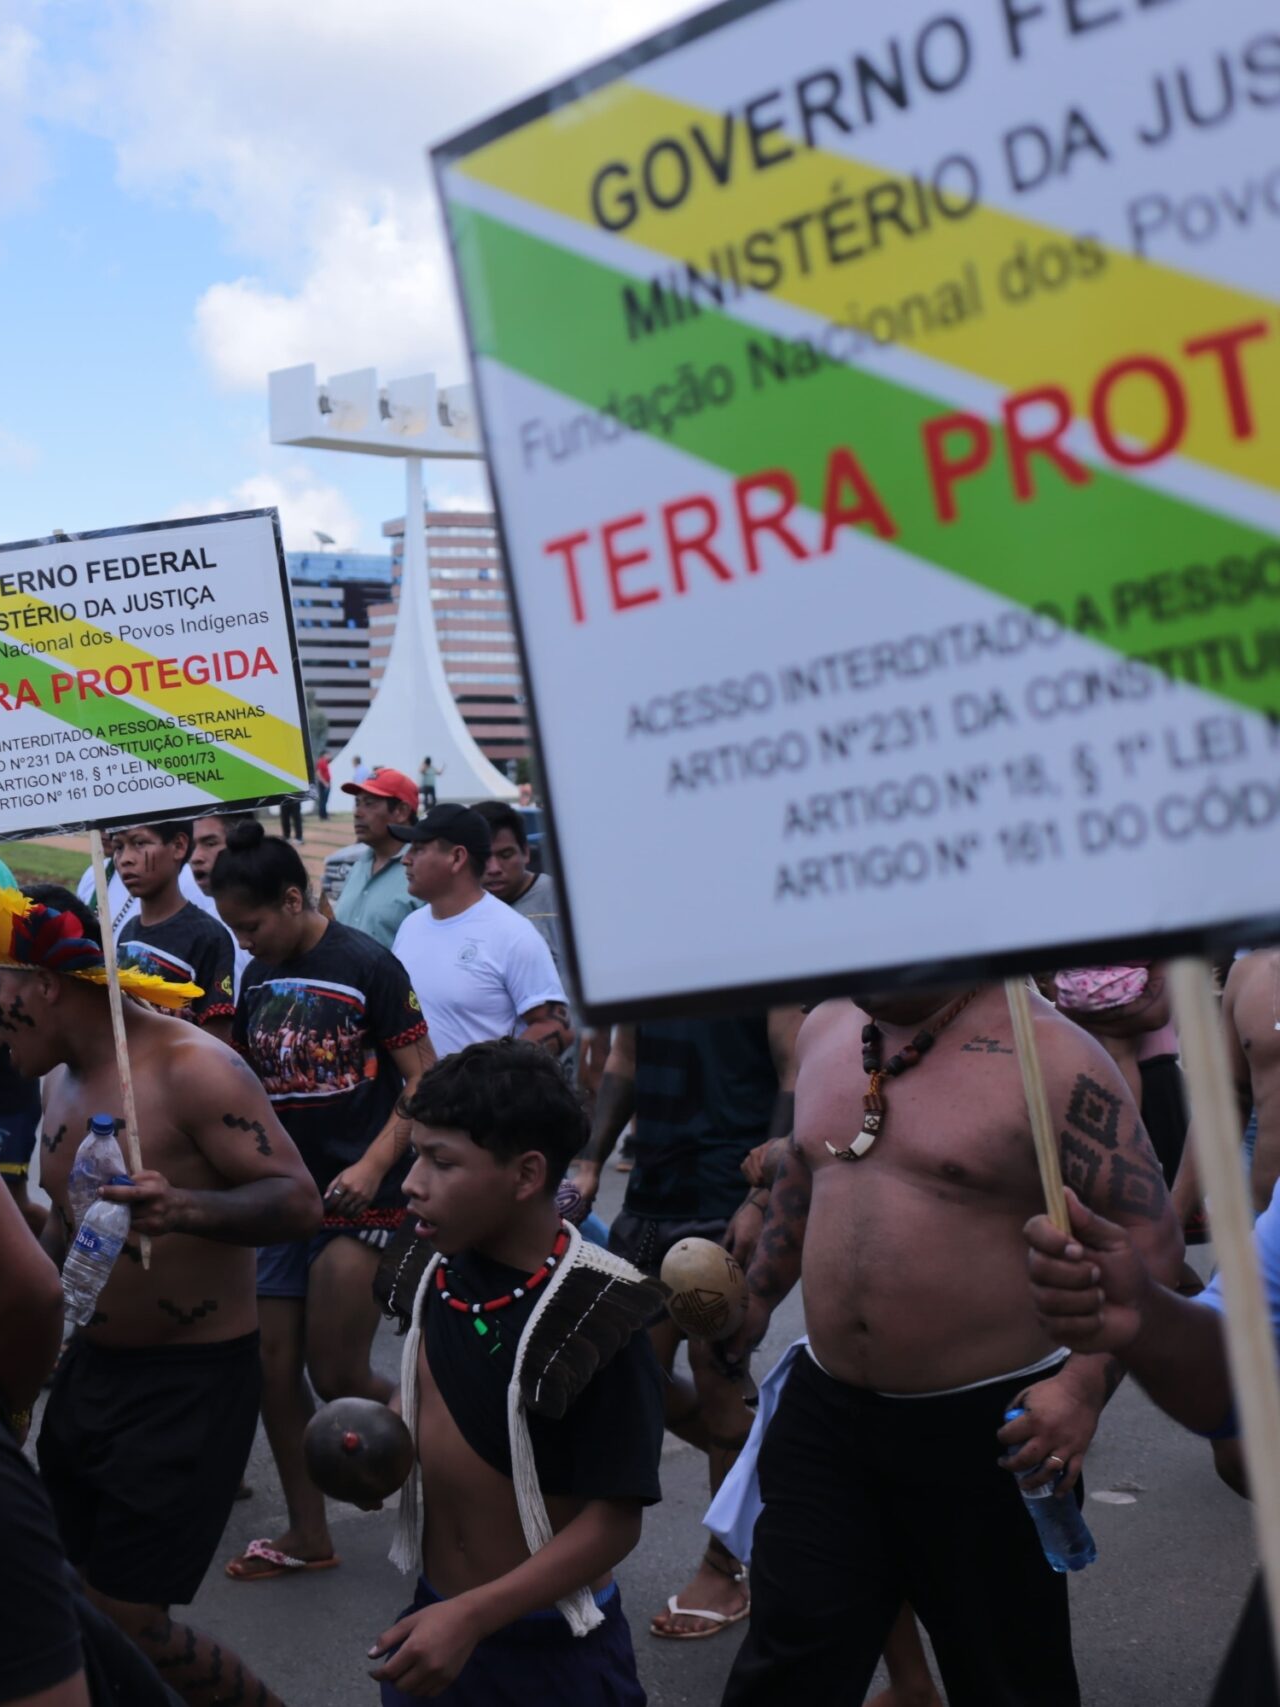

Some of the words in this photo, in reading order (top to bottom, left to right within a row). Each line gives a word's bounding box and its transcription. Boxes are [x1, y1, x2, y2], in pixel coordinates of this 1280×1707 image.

[588, 16, 971, 233] GOVERNO
[619, 153, 980, 343] MINISTÉRIO
[1002, 105, 1111, 194] DA
[518, 357, 735, 471] Fundação
[746, 262, 984, 390] Nacional
[999, 231, 1108, 306] dos
[86, 547, 217, 584] FEDERAL
[542, 445, 900, 625] TERRA
[80, 630, 113, 648] dos
[119, 622, 175, 642] Povos
[180, 610, 270, 634] Indígenas
[84, 598, 116, 618] DA
[122, 585, 216, 613] JUSTIÇA
[51, 646, 279, 704] PROTEGIDA
[627, 671, 775, 740] ACESSO
[779, 603, 1066, 706] INTERDITADO
[55, 750, 76, 764] DA
[79, 734, 184, 762] CONSTITUIÇÃO
[187, 727, 252, 746] FEDERAL
[95, 726, 106, 739] A
[109, 717, 176, 737] PESSOAS
[178, 705, 266, 728] ESTRANHAS
[666, 731, 809, 795] ARTIGO
[951, 688, 1015, 737] DA
[67, 787, 88, 801] 161
[92, 783, 115, 797] DO
[117, 776, 176, 794] CÓDIGO
[178, 769, 224, 785] PENAL
[70, 769, 89, 783] 18,
[92, 768, 101, 782] §
[121, 760, 143, 775] LEI
[783, 775, 942, 843] ARTIGO
[1164, 717, 1247, 770] LEI
[774, 839, 942, 901] ARTIGO
[1078, 801, 1149, 854] DO
